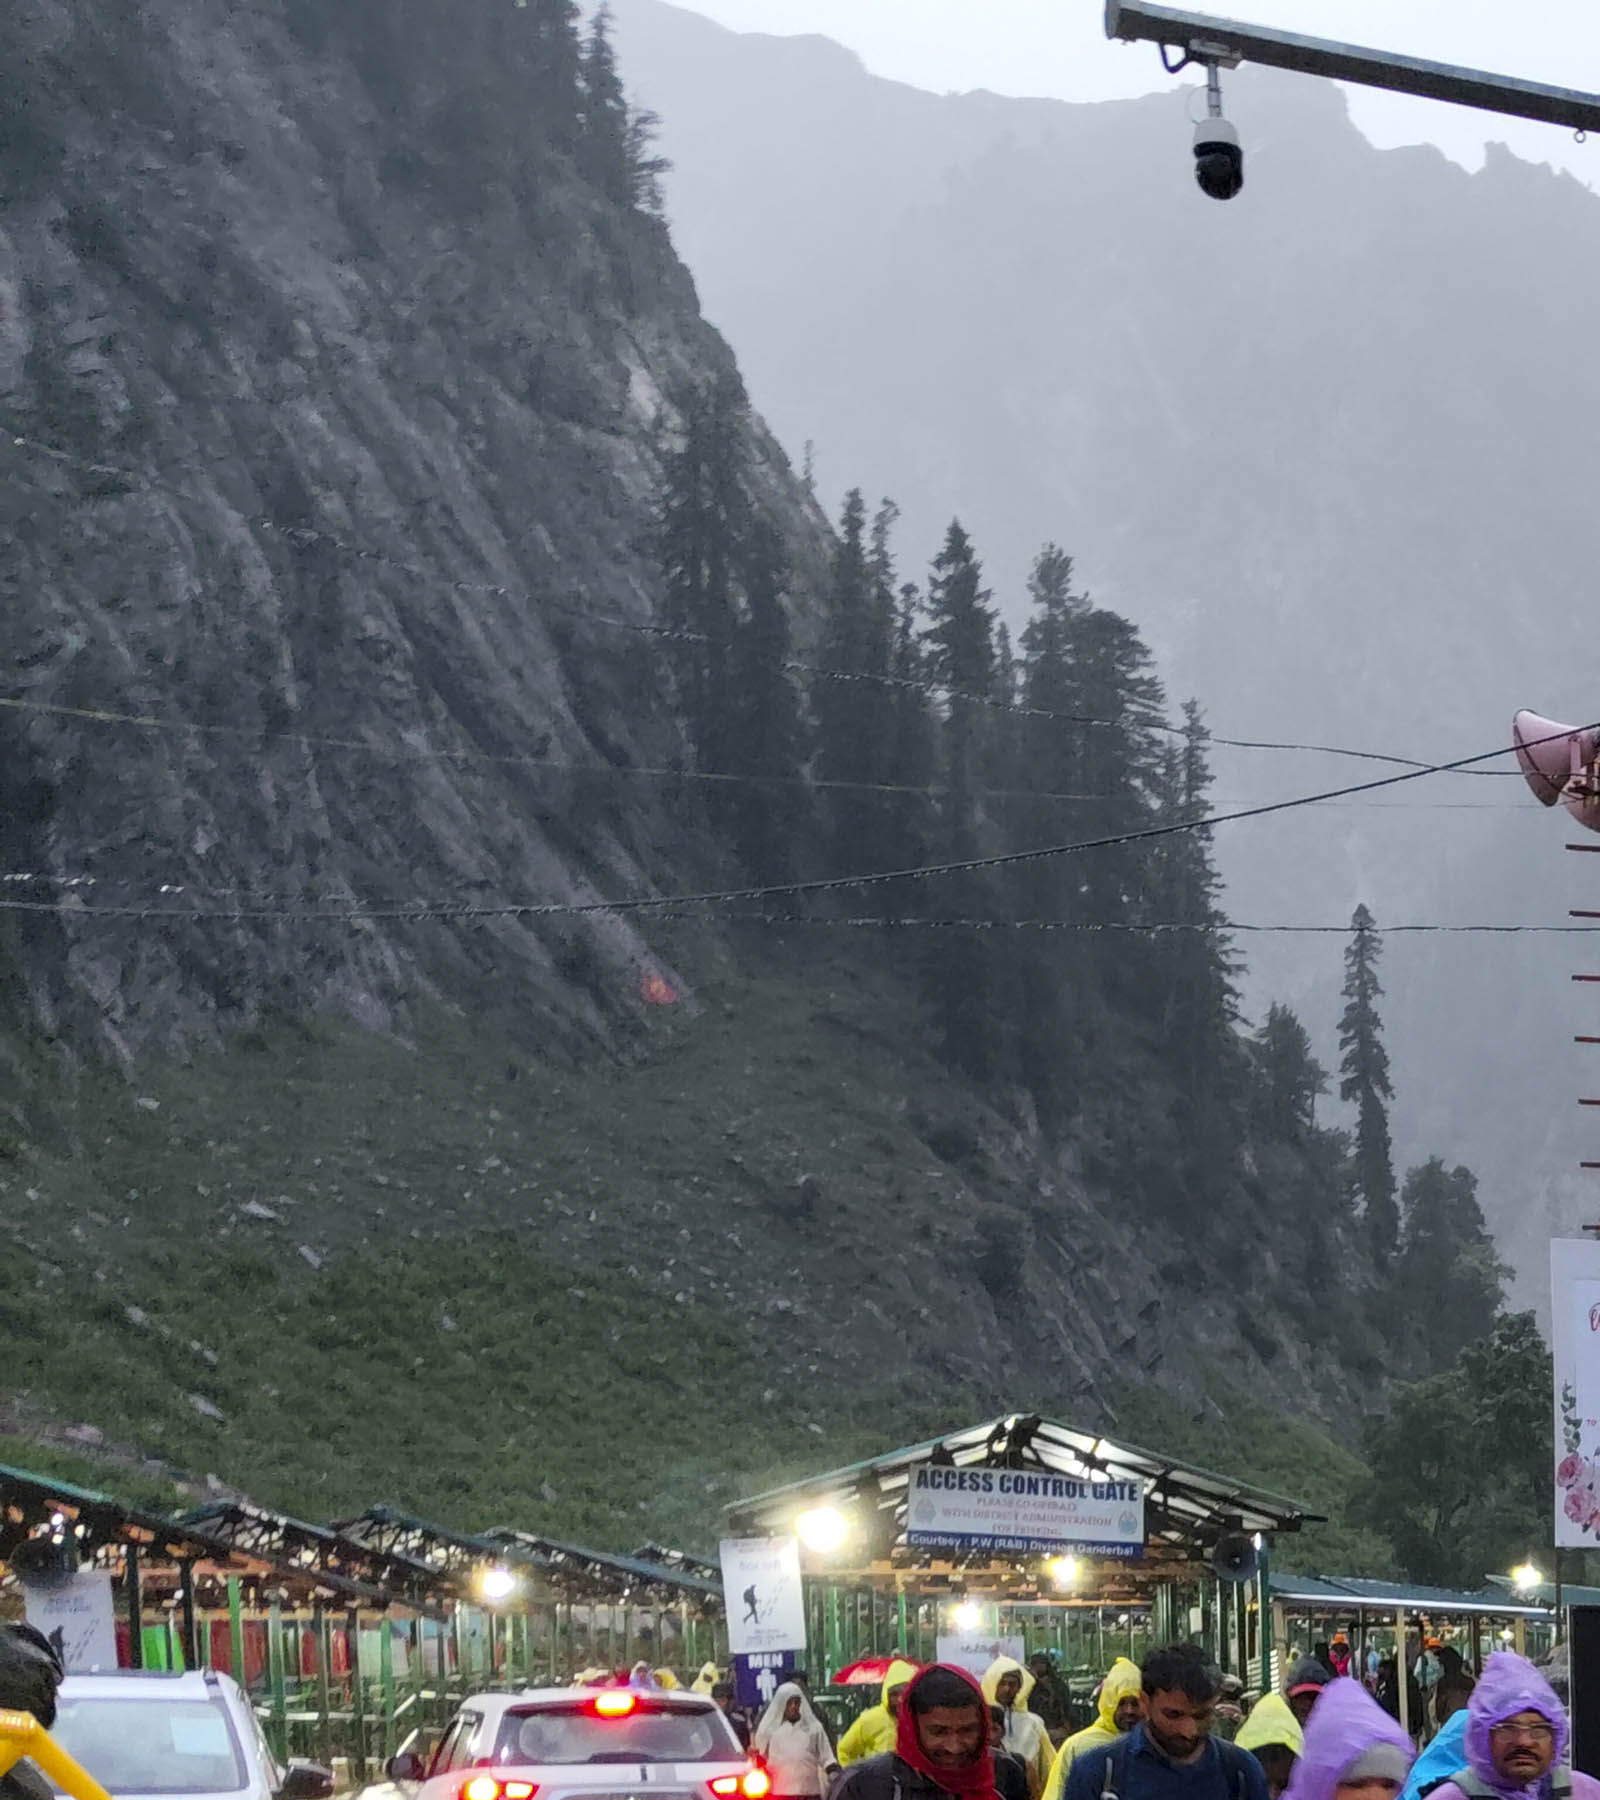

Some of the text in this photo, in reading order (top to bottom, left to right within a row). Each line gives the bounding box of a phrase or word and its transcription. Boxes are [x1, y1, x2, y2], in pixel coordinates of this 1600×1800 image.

[916, 1469, 1138, 1501] ACCESS CONTROL GATE
